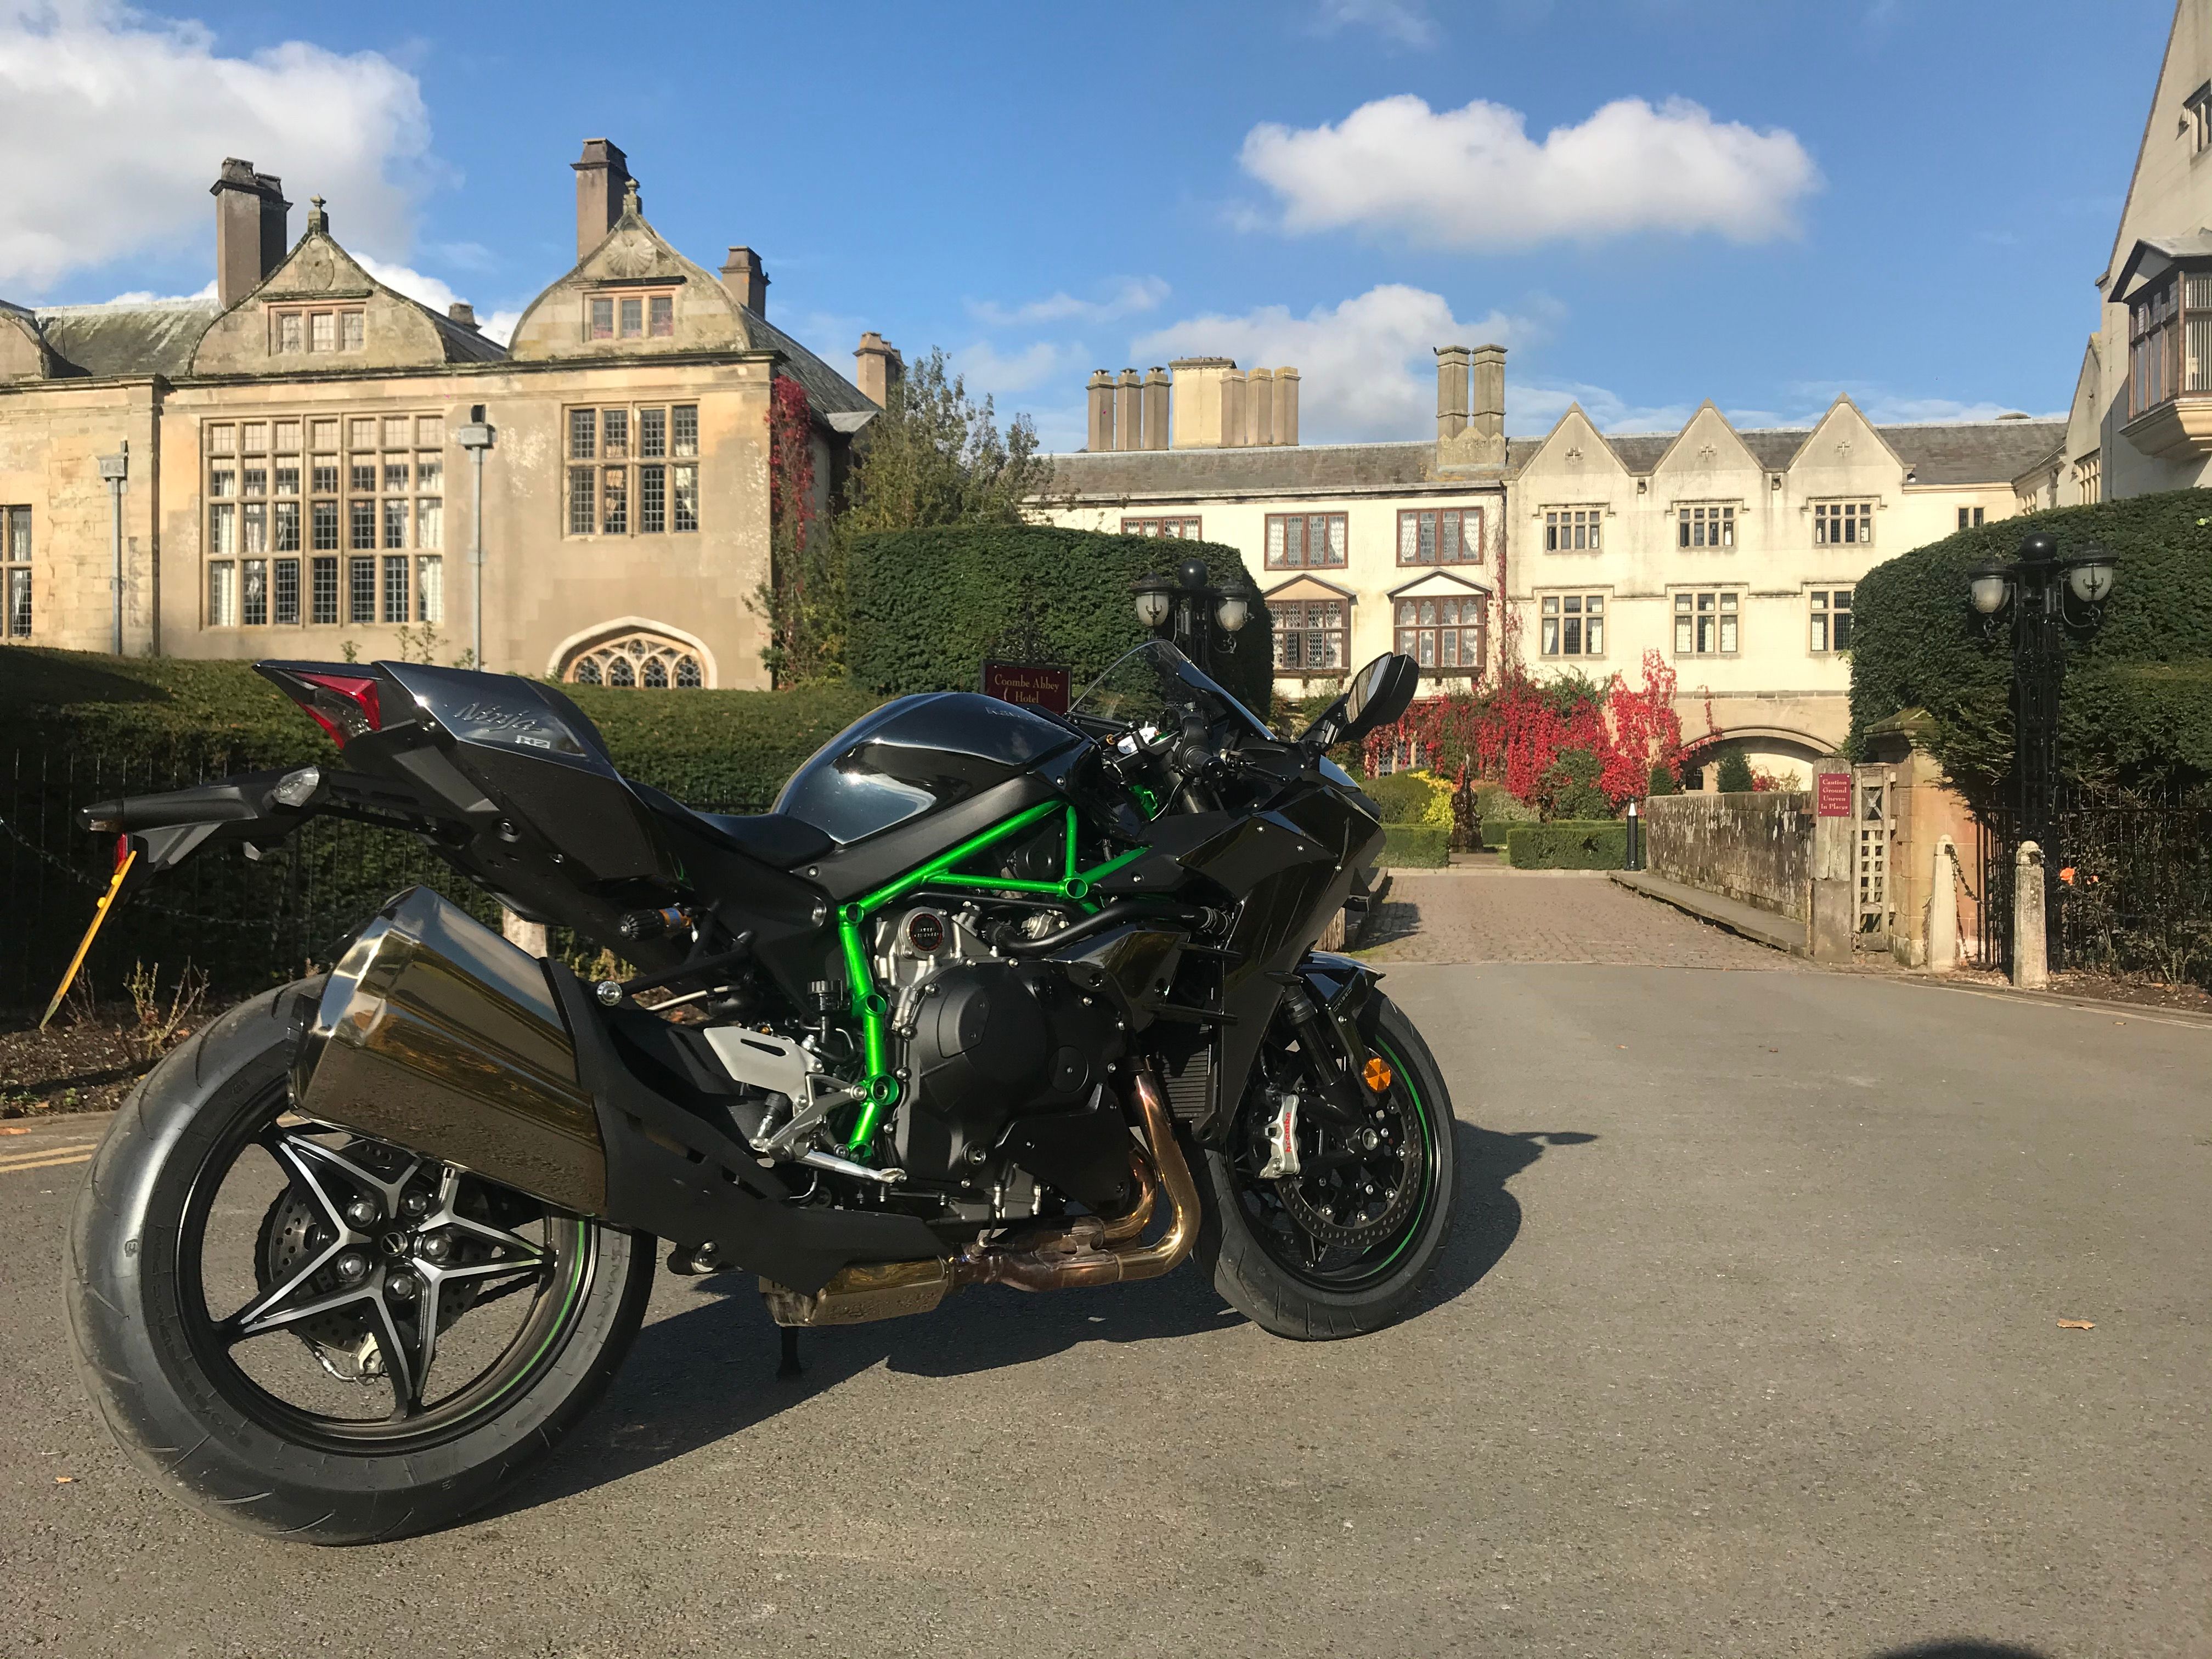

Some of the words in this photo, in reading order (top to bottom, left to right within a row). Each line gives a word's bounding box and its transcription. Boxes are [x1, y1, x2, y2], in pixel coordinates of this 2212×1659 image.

[994, 674, 1030, 687] Coombe
[1032, 676, 1059, 692] Abbey
[1015, 691, 1039, 703] Hotel
[453, 702, 542, 731] Ninja
[518, 736, 549, 749] H2
